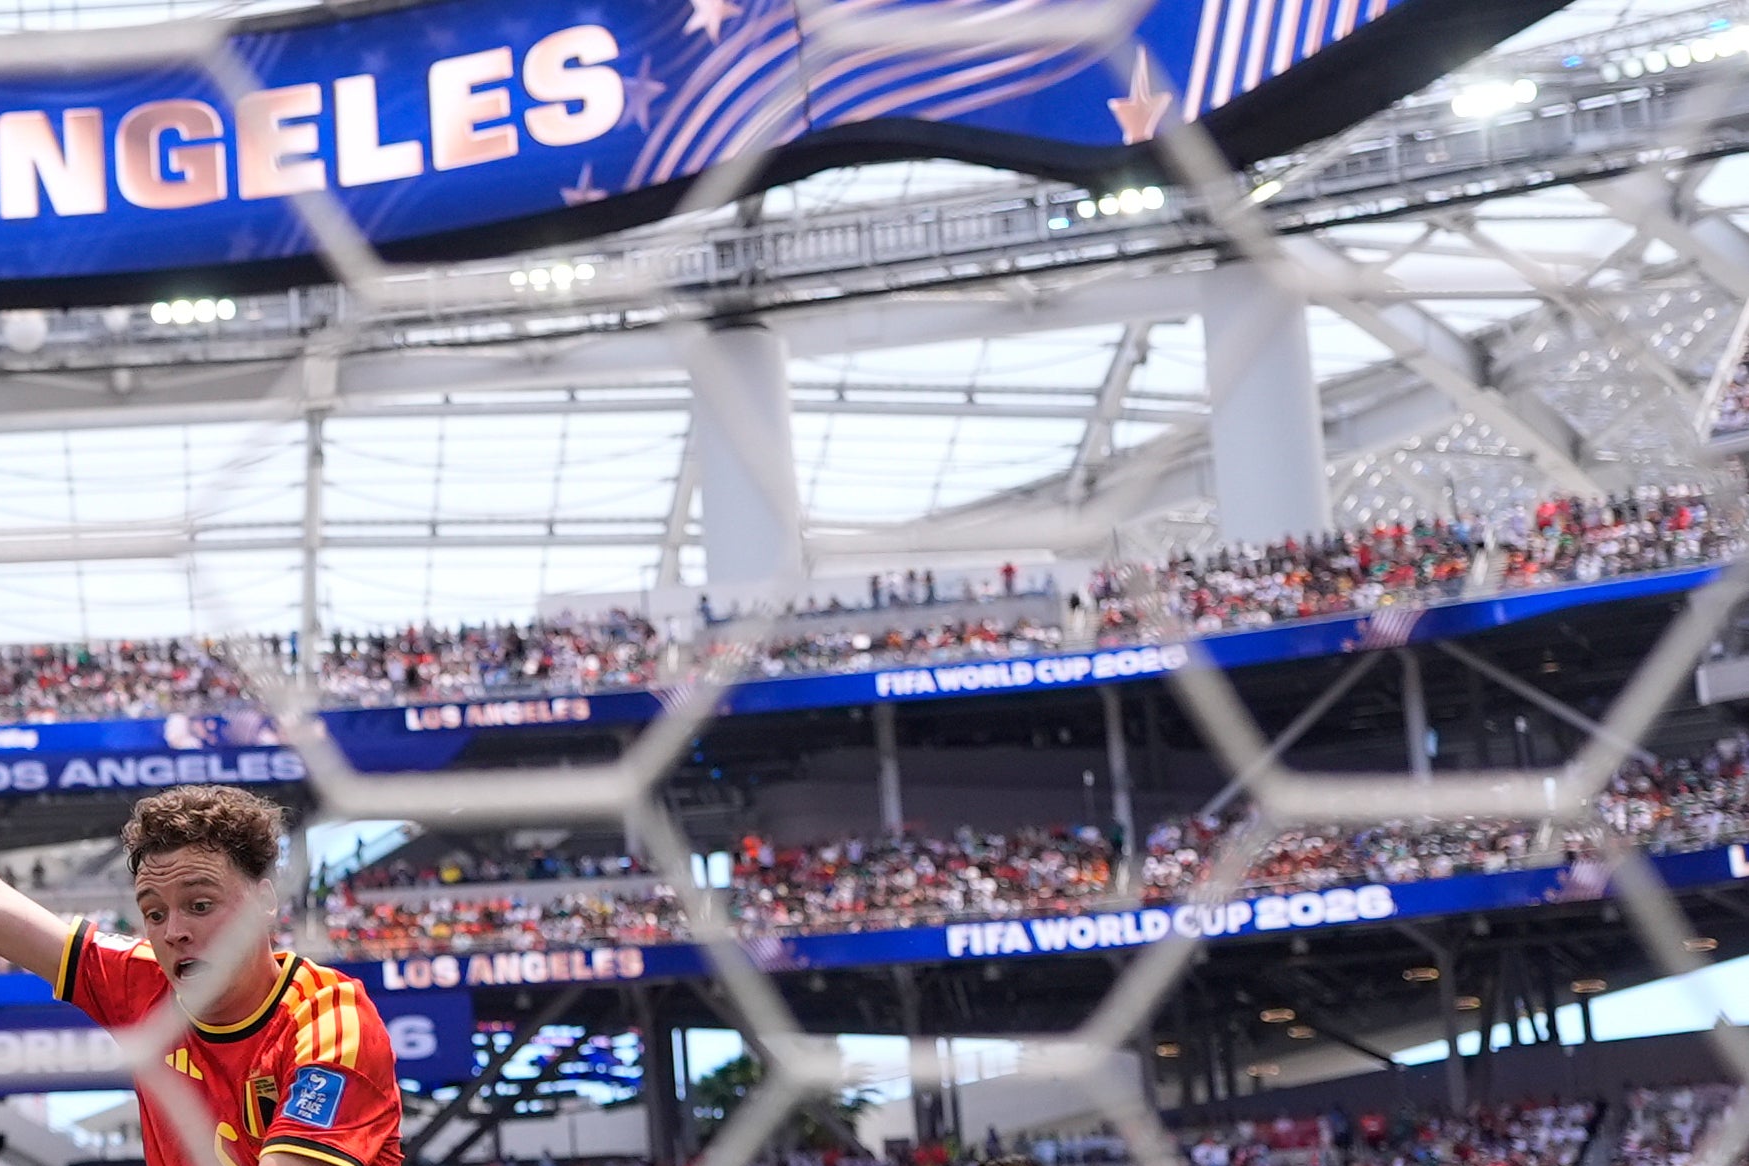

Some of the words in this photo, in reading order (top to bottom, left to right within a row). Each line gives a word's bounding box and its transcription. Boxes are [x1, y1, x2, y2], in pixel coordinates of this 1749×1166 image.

[875, 670, 936, 697] FIFA
[933, 661, 1035, 691] WORLD
[1034, 656, 1091, 683] CUP
[405, 704, 461, 731] LOS
[464, 698, 591, 727] ANGELES
[59, 751, 306, 789] ANGELES
[946, 921, 1033, 957] FIFA
[1033, 909, 1171, 951] WORLD
[1172, 900, 1253, 938] CUP
[1254, 885, 1393, 931] 2026
[382, 955, 460, 990] LOS
[466, 947, 644, 986] ANGELES
